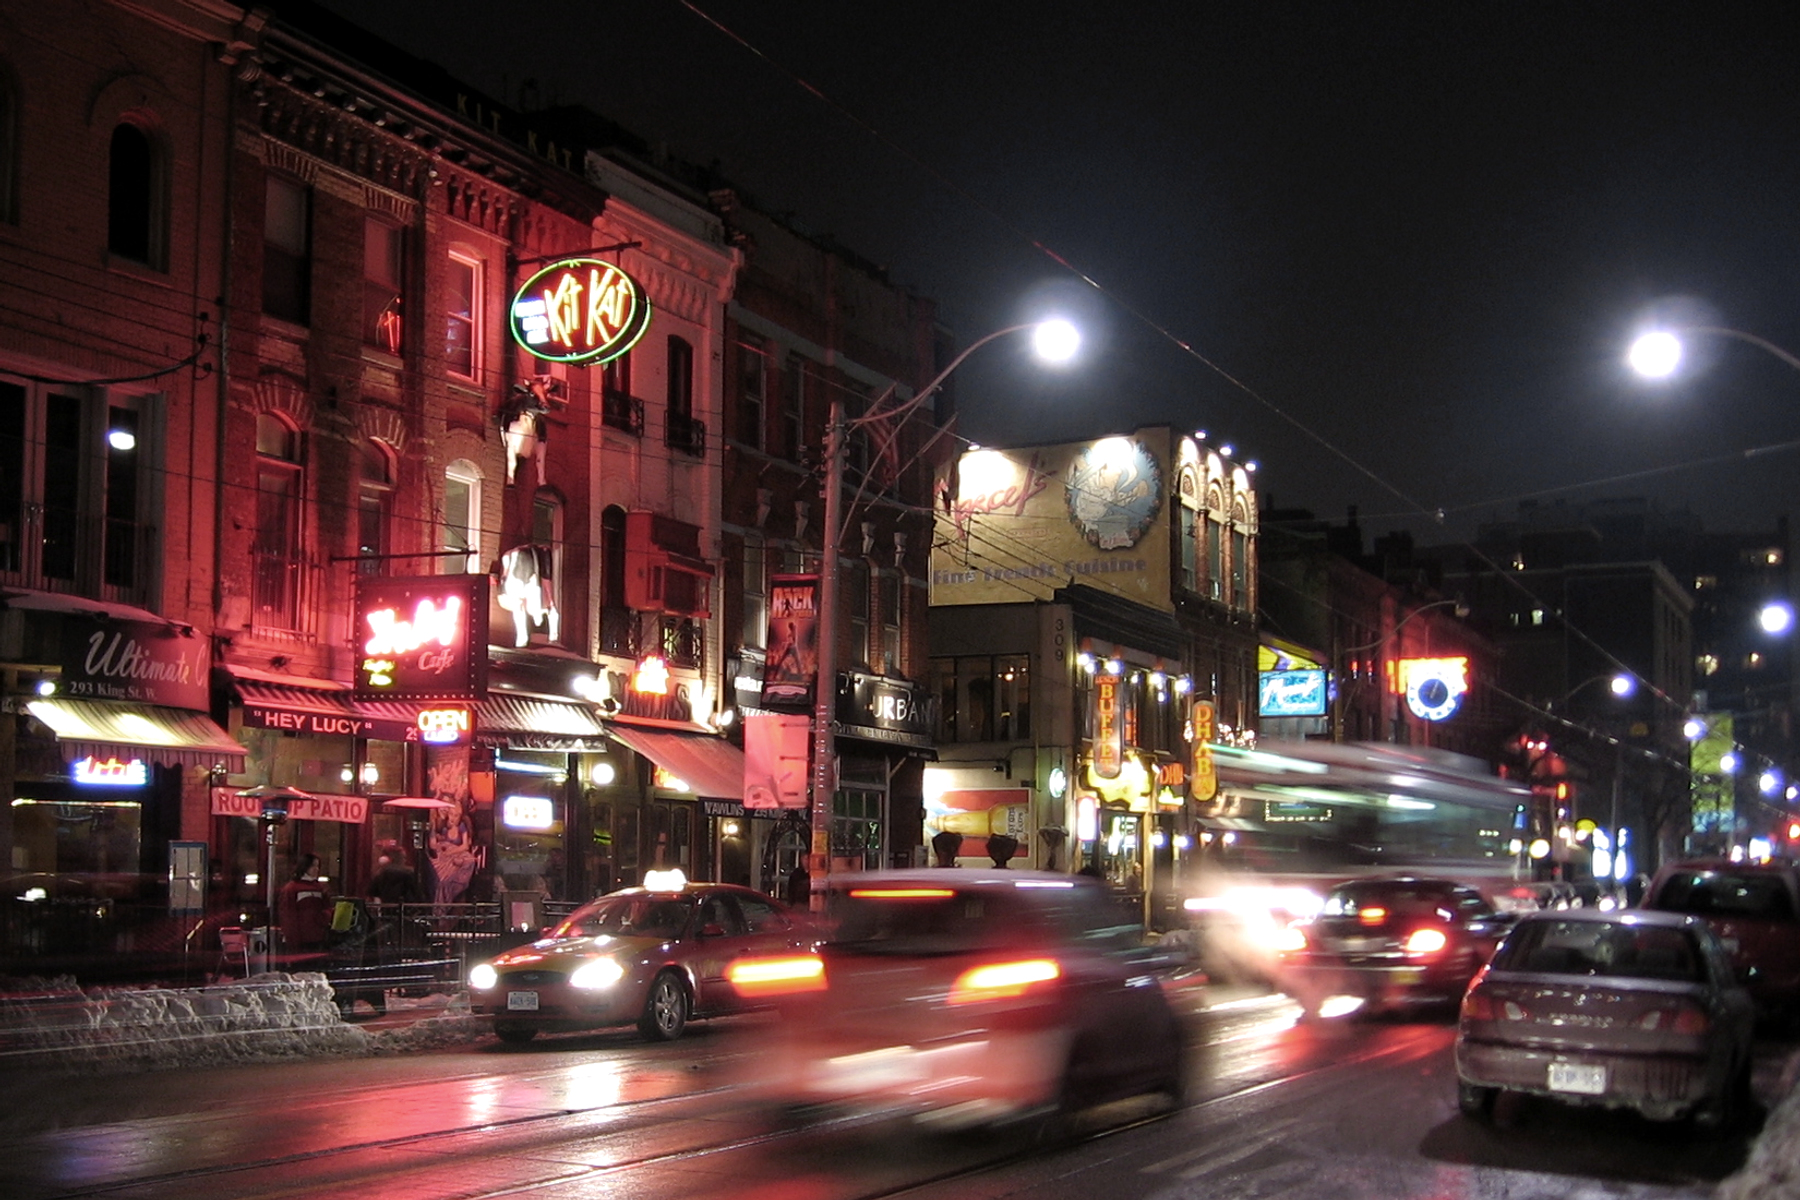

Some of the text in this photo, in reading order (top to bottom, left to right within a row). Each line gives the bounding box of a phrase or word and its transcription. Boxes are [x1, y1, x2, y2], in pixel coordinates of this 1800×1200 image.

[457, 93, 573, 171] KIT KAT
[933, 569, 976, 585] Fine
[1064, 560, 1147, 577] Cuisine
[85, 631, 190, 684] Ultimate
[70, 681, 94, 694] 293
[97, 683, 125, 699] King
[128, 685, 142, 698] St.
[418, 711, 469, 731] OPEN
[218, 793, 362, 819] ROOP PATIO
